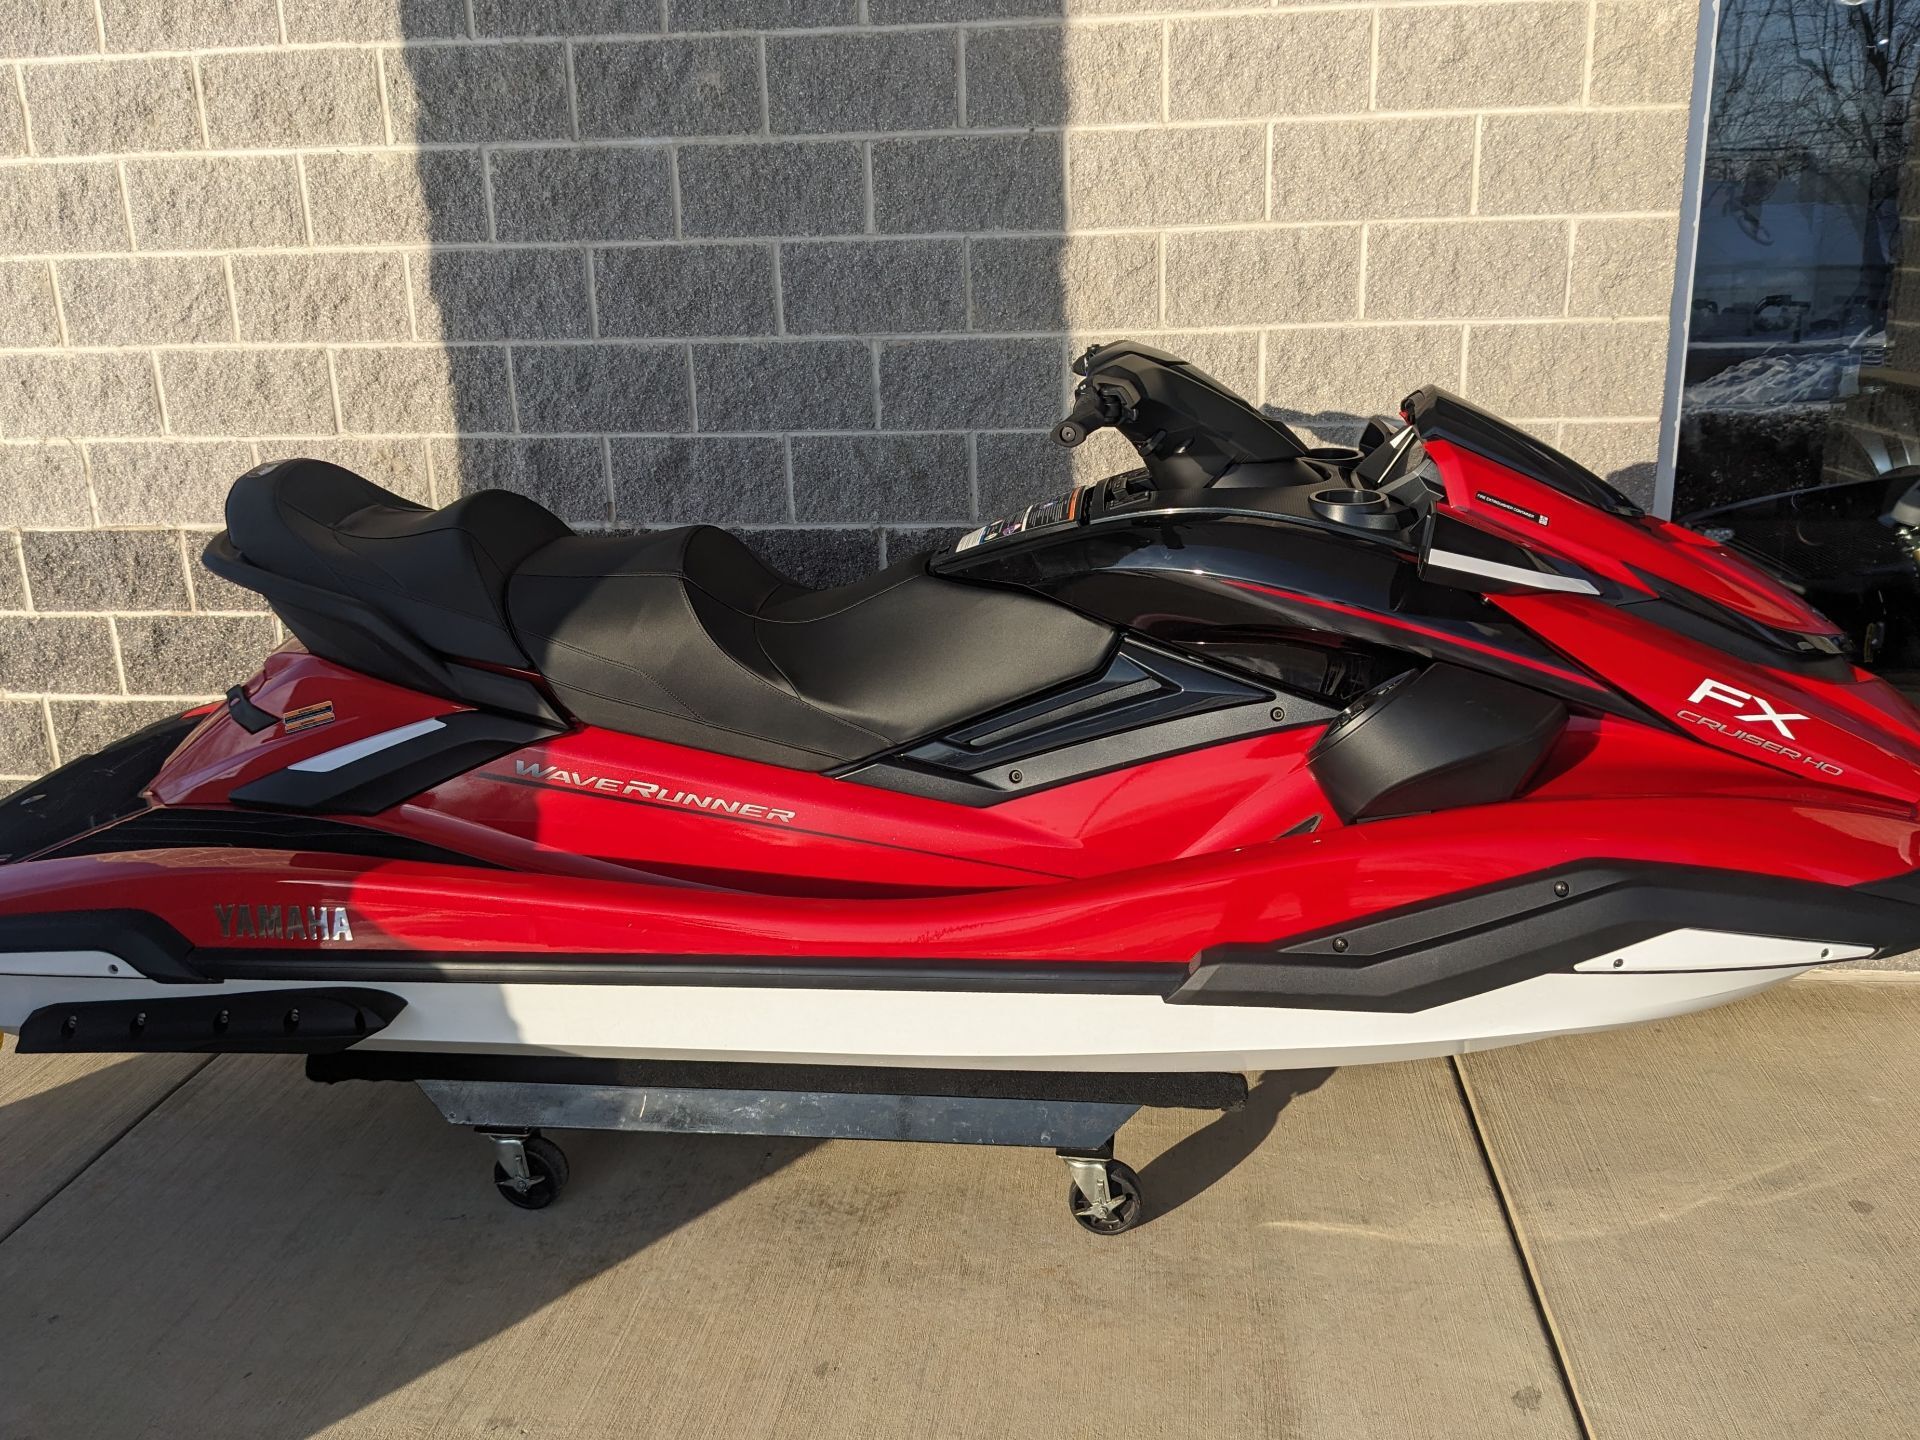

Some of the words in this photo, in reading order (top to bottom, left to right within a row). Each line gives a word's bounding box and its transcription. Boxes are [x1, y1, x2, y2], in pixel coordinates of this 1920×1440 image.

[1687, 678, 1811, 741] FX
[1676, 710, 1802, 760] CRUISER
[1803, 756, 1844, 776] HO
[213, 903, 354, 942] YAMAHA
